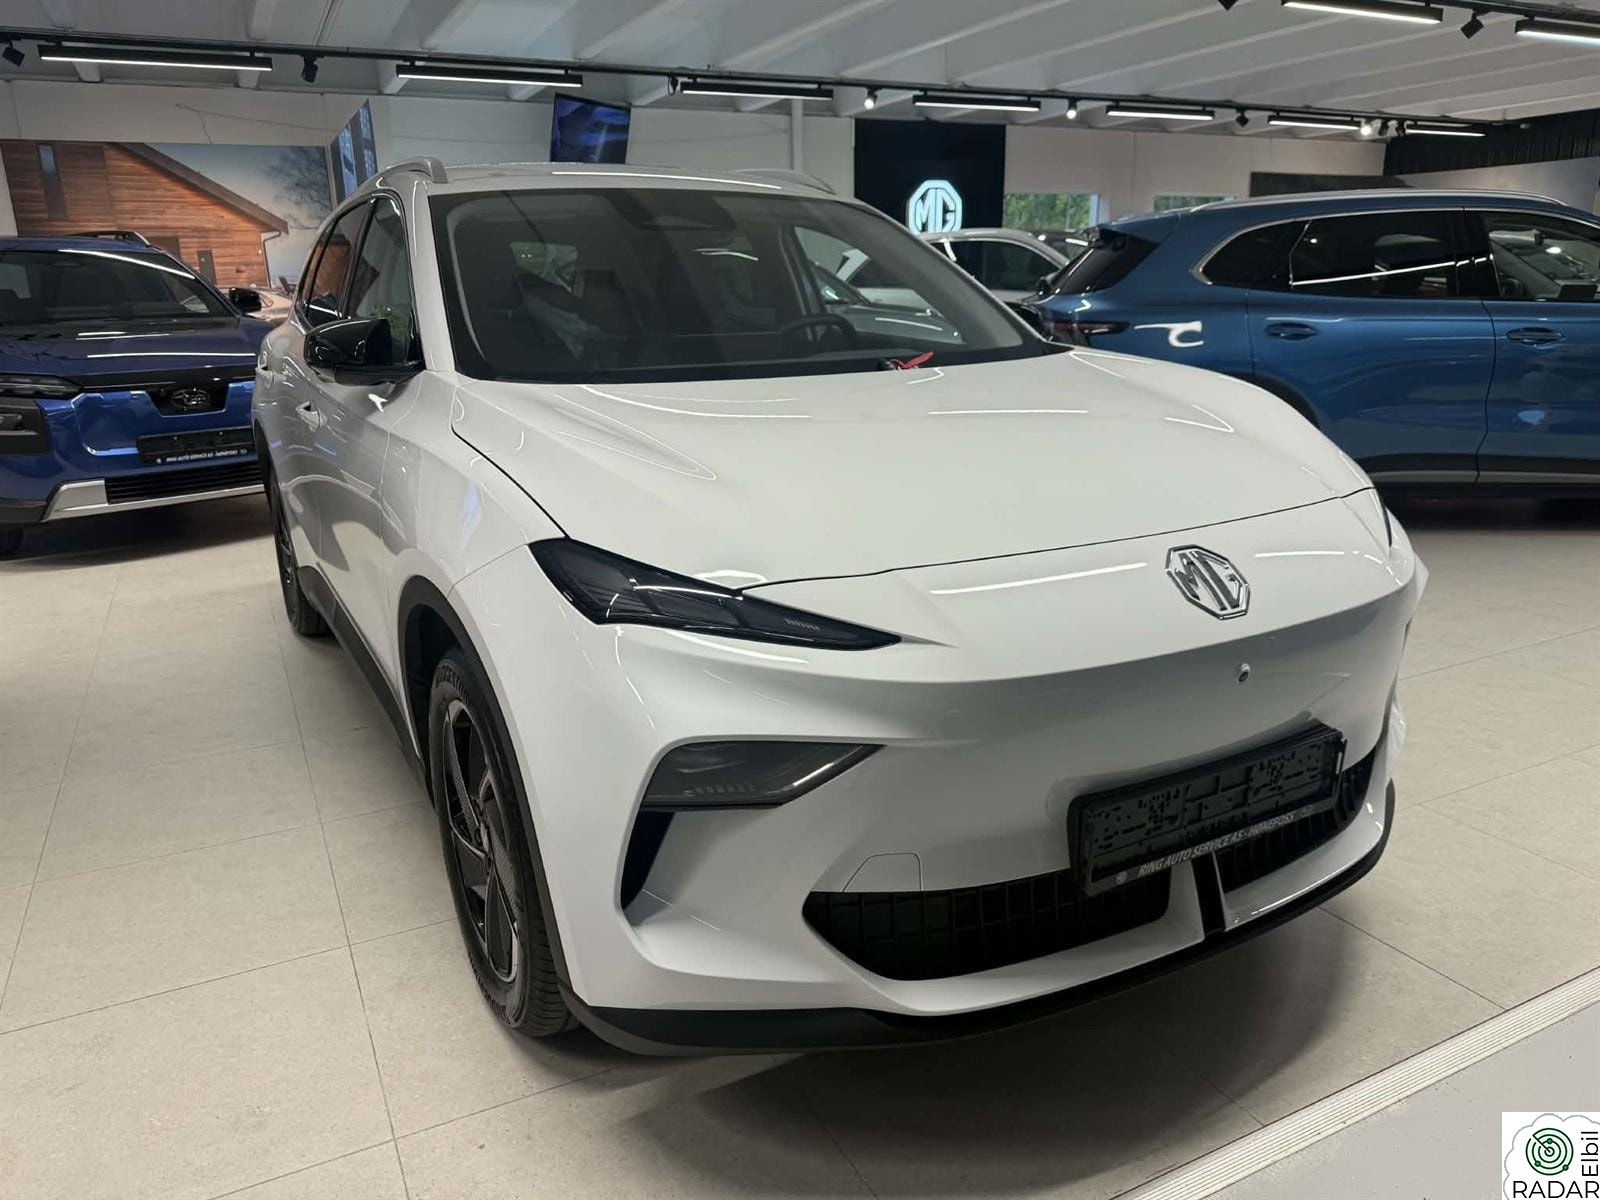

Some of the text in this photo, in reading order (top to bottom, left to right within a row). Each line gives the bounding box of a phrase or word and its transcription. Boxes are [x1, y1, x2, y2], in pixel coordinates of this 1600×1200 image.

[914, 186, 957, 234] MG
[1173, 549, 1242, 612] MG
[1138, 857, 1165, 877] RING
[1164, 848, 1192, 868] AUTO
[1191, 835, 1231, 858] SERVICE
[1229, 829, 1244, 844] AS
